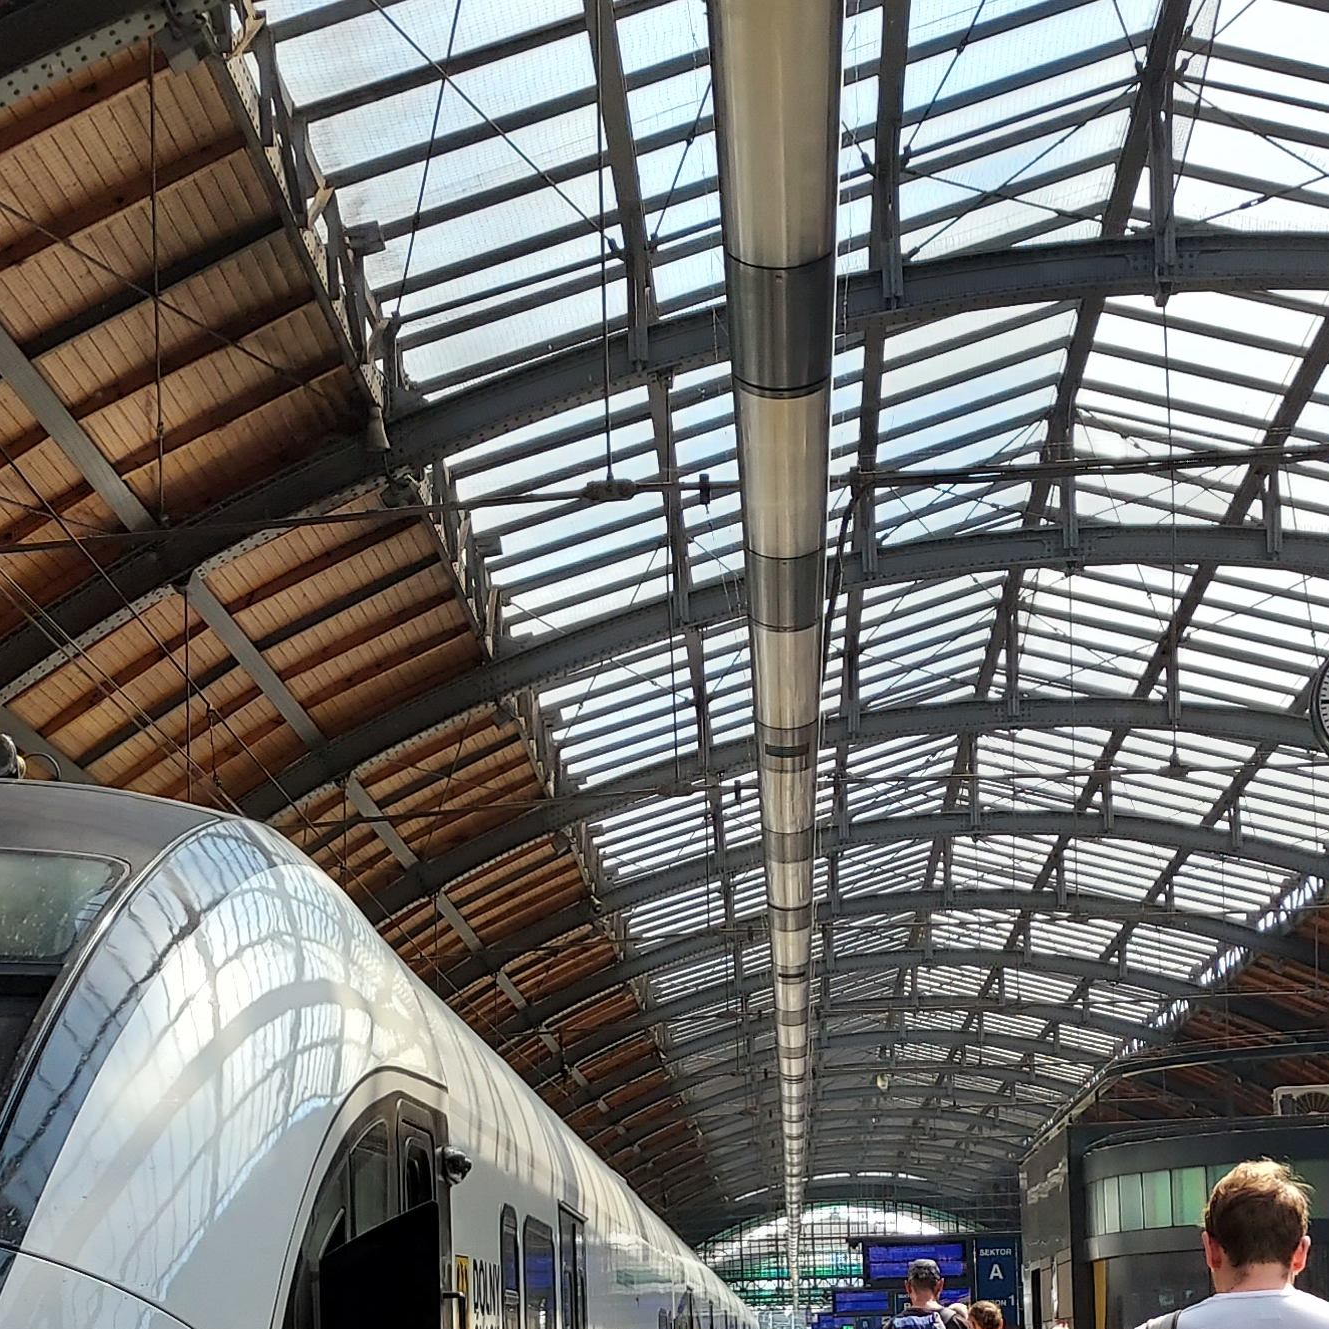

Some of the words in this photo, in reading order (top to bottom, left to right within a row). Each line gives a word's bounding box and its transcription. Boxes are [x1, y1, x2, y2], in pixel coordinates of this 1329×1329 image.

[979, 1248, 1012, 1257] SEKTOR
[988, 1263, 1004, 1280] A
[472, 1258, 500, 1317] DOLNY
[1008, 1294, 1015, 1306] 1
